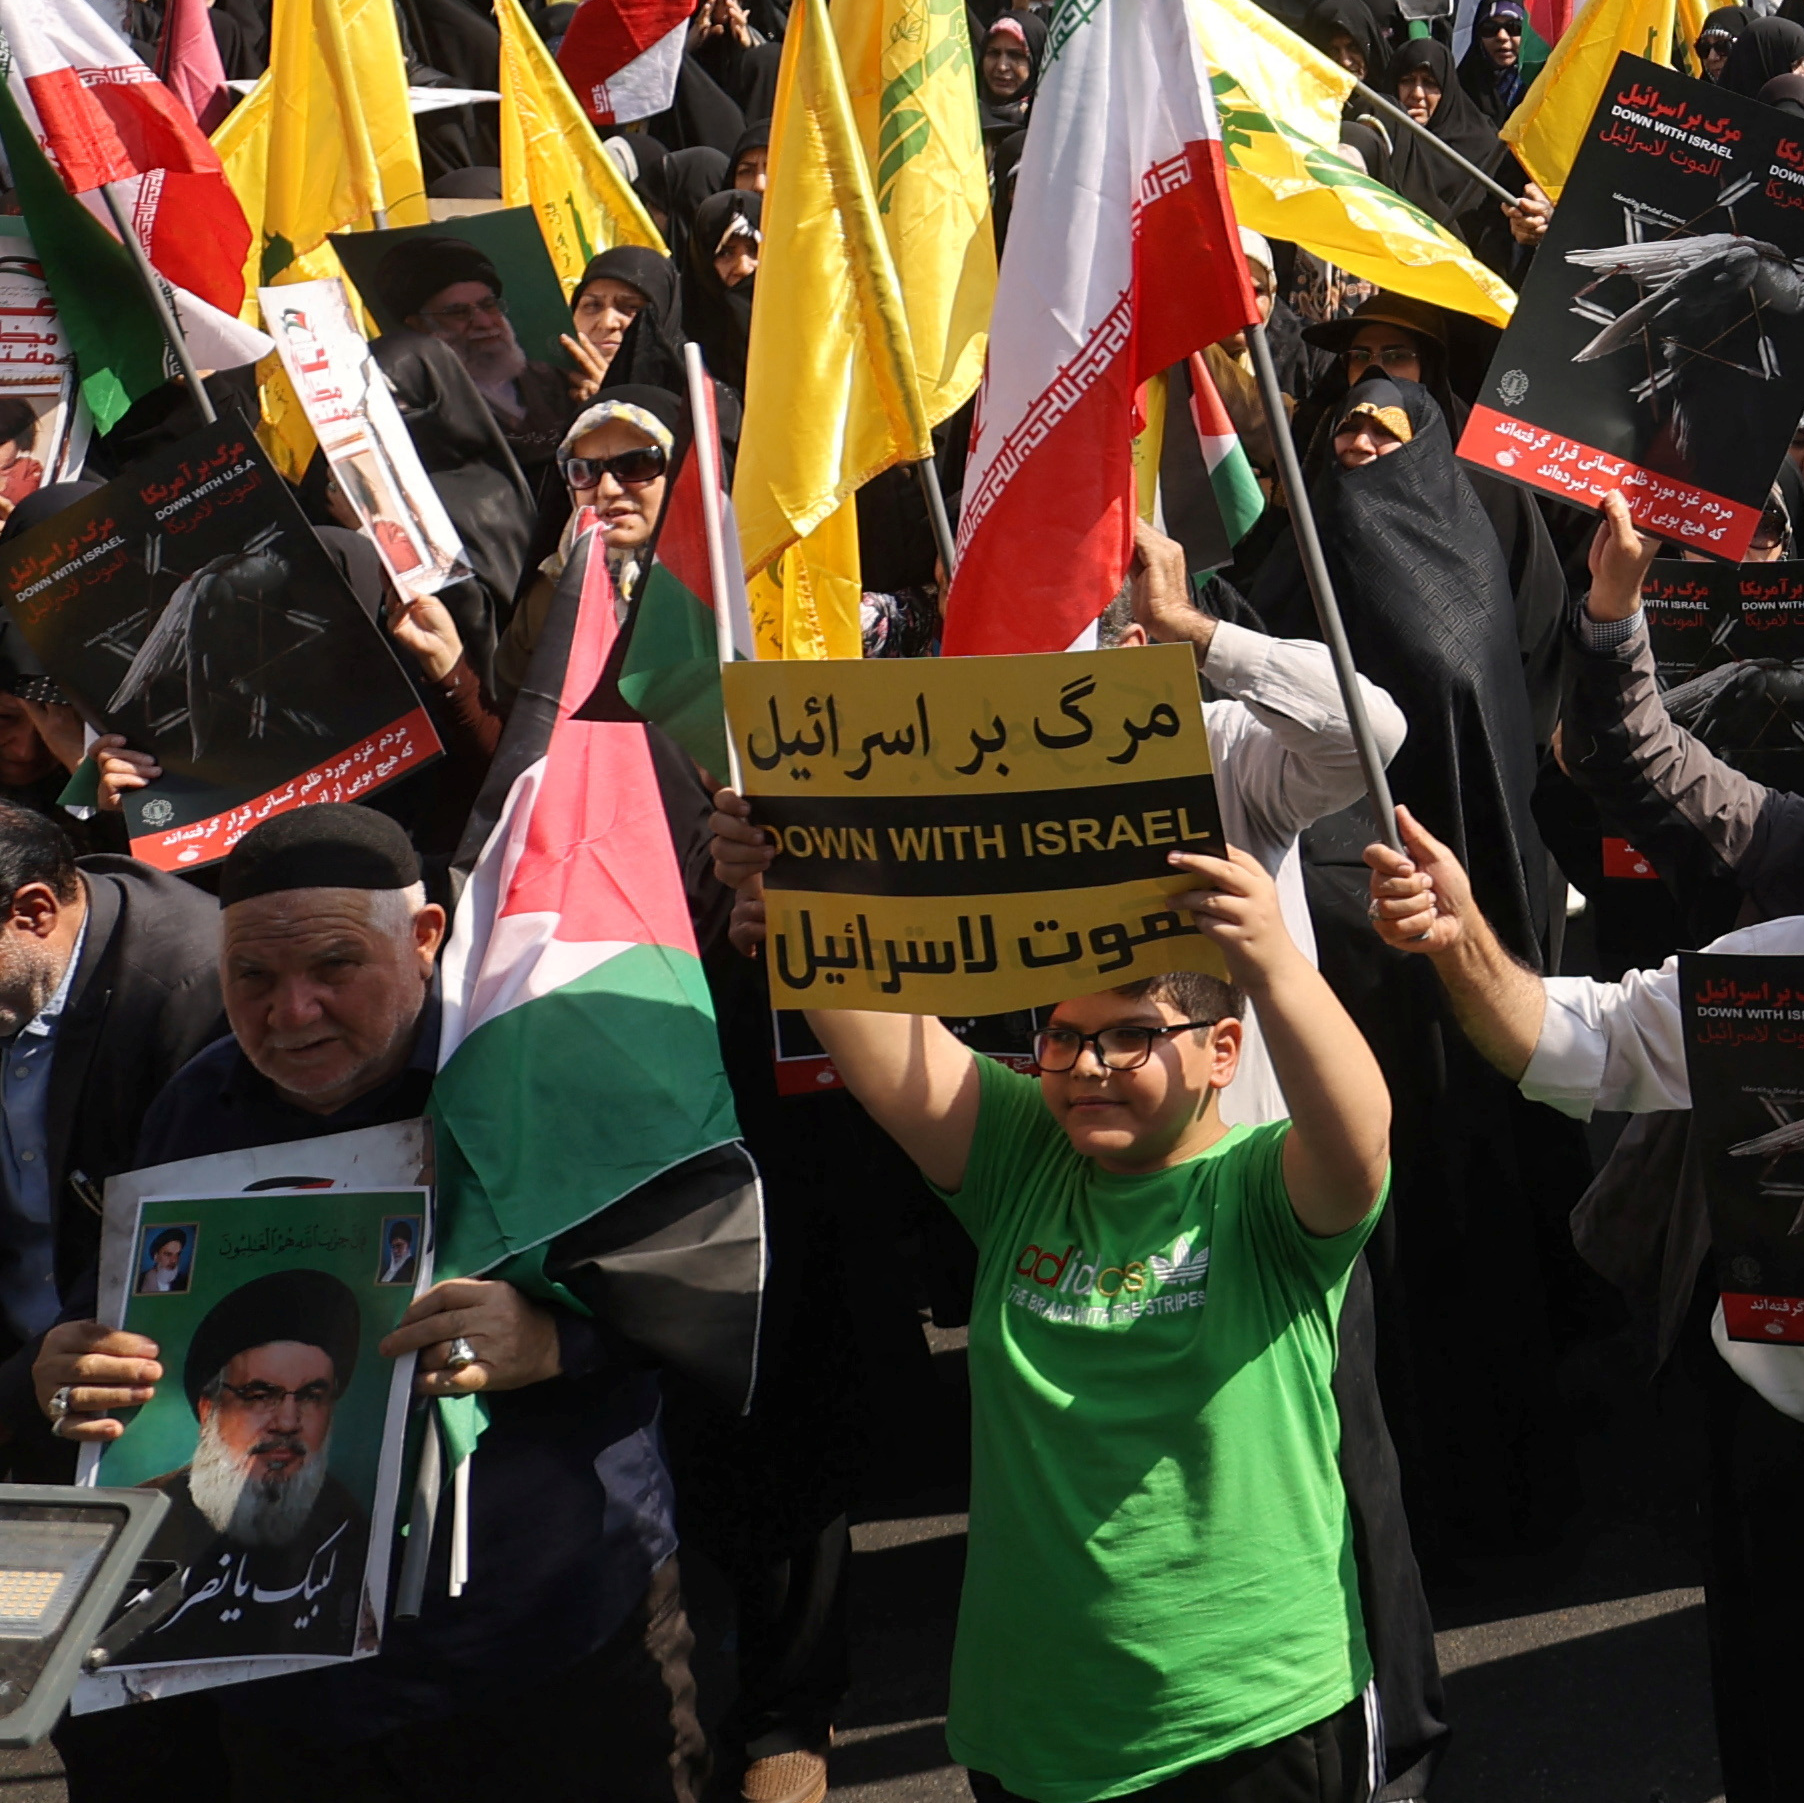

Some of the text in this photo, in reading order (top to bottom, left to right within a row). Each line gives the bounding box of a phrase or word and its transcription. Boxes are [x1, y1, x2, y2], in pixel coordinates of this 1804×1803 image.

[1611, 105, 1733, 159] DOWN WITH ISRAEL
[1680, 114, 1702, 130] بر
[1704, 118, 1743, 143] مرگ
[1549, 442, 1581, 462] قرار
[1577, 455, 1626, 476] کسانی
[1621, 470, 1649, 487] ظلم
[155, 458, 256, 521] DOWN WITH U.S.A
[1650, 480, 1675, 499] مورد
[1678, 492, 1701, 507] غزه
[1699, 501, 1733, 521] مردم
[1679, 519, 1706, 536] هیچ
[1708, 527, 1727, 541] که
[16, 535, 127, 603] DOWN WITH ISRAEL
[1671, 601, 1710, 611] ISRAEL
[1741, 602, 1777, 611] DOWN
[747, 674, 1181, 782] مرگ بر اسرائیل
[378, 727, 407, 751] مردم
[353, 741, 376, 762] غزه
[325, 758, 351, 779] مورد
[300, 772, 322, 796] ظلم
[227, 805, 252, 831] قرار
[760, 807, 1211, 862] DOWN WITH ISRAEL
[1018, 909, 1203, 974] موت
[1772, 987, 1792, 1007] بر
[1697, 1006, 1743, 1019] DOWN
[1745, 1008, 1784, 1020] WITH
[1015, 1244, 1145, 1297] adidas
[1008, 1284, 1206, 1325] THE BRAND WITH THE STRIPES
[253, 1518, 350, 1631] لبیک
